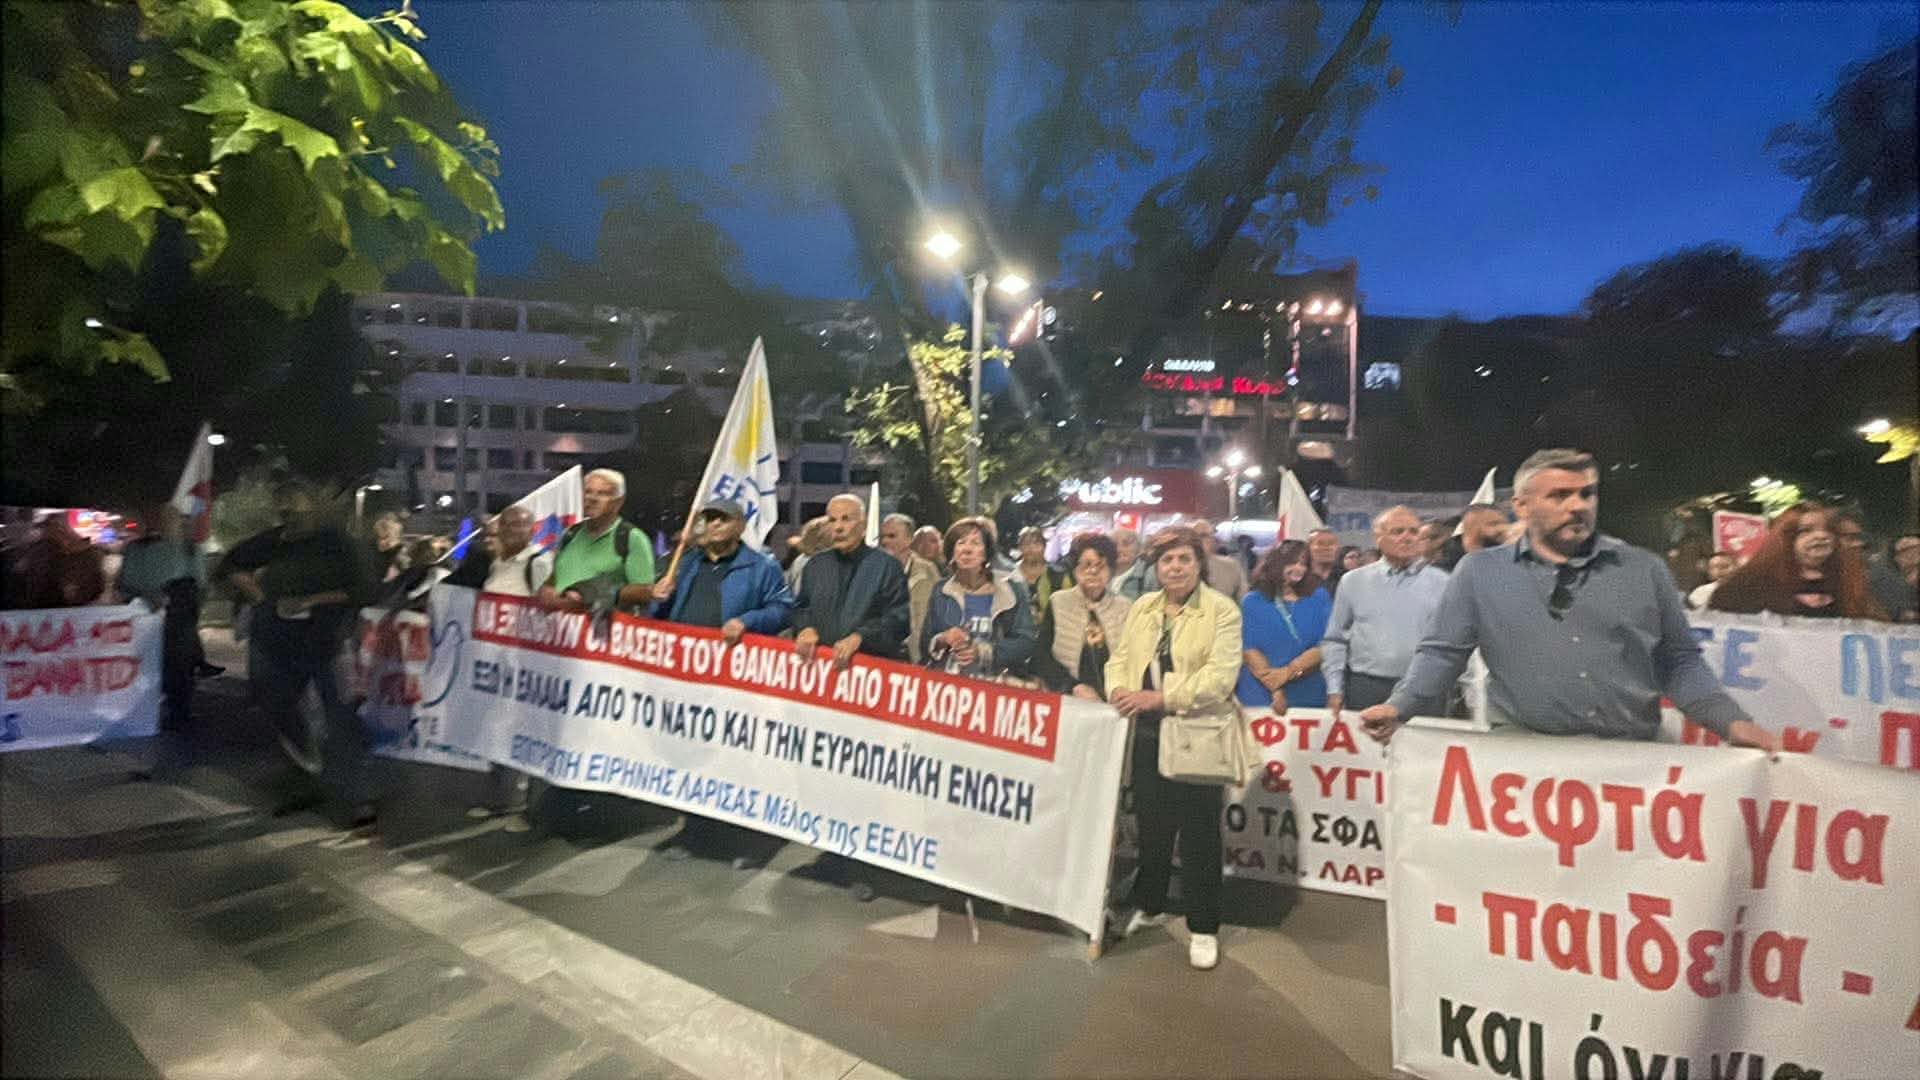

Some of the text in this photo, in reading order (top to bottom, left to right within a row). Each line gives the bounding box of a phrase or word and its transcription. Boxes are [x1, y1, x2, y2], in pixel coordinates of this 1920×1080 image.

[610, 621, 678, 669] ΒΑΣΕΙΣ
[681, 637, 728, 677] ΤΟΥ
[730, 645, 832, 701] ΘΑΝΑΤΟΥ
[834, 669, 881, 707] ΑΠΟ
[886, 672, 922, 716] ΤΗ
[922, 680, 987, 734] ΧΩΡΑ
[992, 695, 1052, 748] ΜΑΣ
[575, 682, 625, 722] ΑΠΟ
[632, 691, 655, 728] ΤΟ
[660, 700, 716, 742] ΝΑΤΟ
[722, 709, 758, 752] ΚΑΙ
[765, 719, 807, 764] ΤΗΝ
[811, 731, 942, 801] ΕΥΡΩΠΑΪΚΗ
[946, 767, 1035, 824] ΕΝΩΣΗ
[1261, 761, 1293, 793] &
[586, 753, 677, 796] ΕΙΡΗΝΗΣ
[676, 775, 759, 819] ΛΑΡΙΣΑΣ
[763, 795, 821, 846] Μέλος
[826, 821, 858, 857] της
[864, 822, 940, 872] ΕΕΔΥΕ
[1257, 807, 1300, 840] ΤΑ
[1311, 813, 1383, 851] ΣΦΑ
[1432, 745, 1890, 889] Λεφτά για
[1482, 891, 1808, 1005] παιδεία
[1439, 997, 1544, 1080] και
